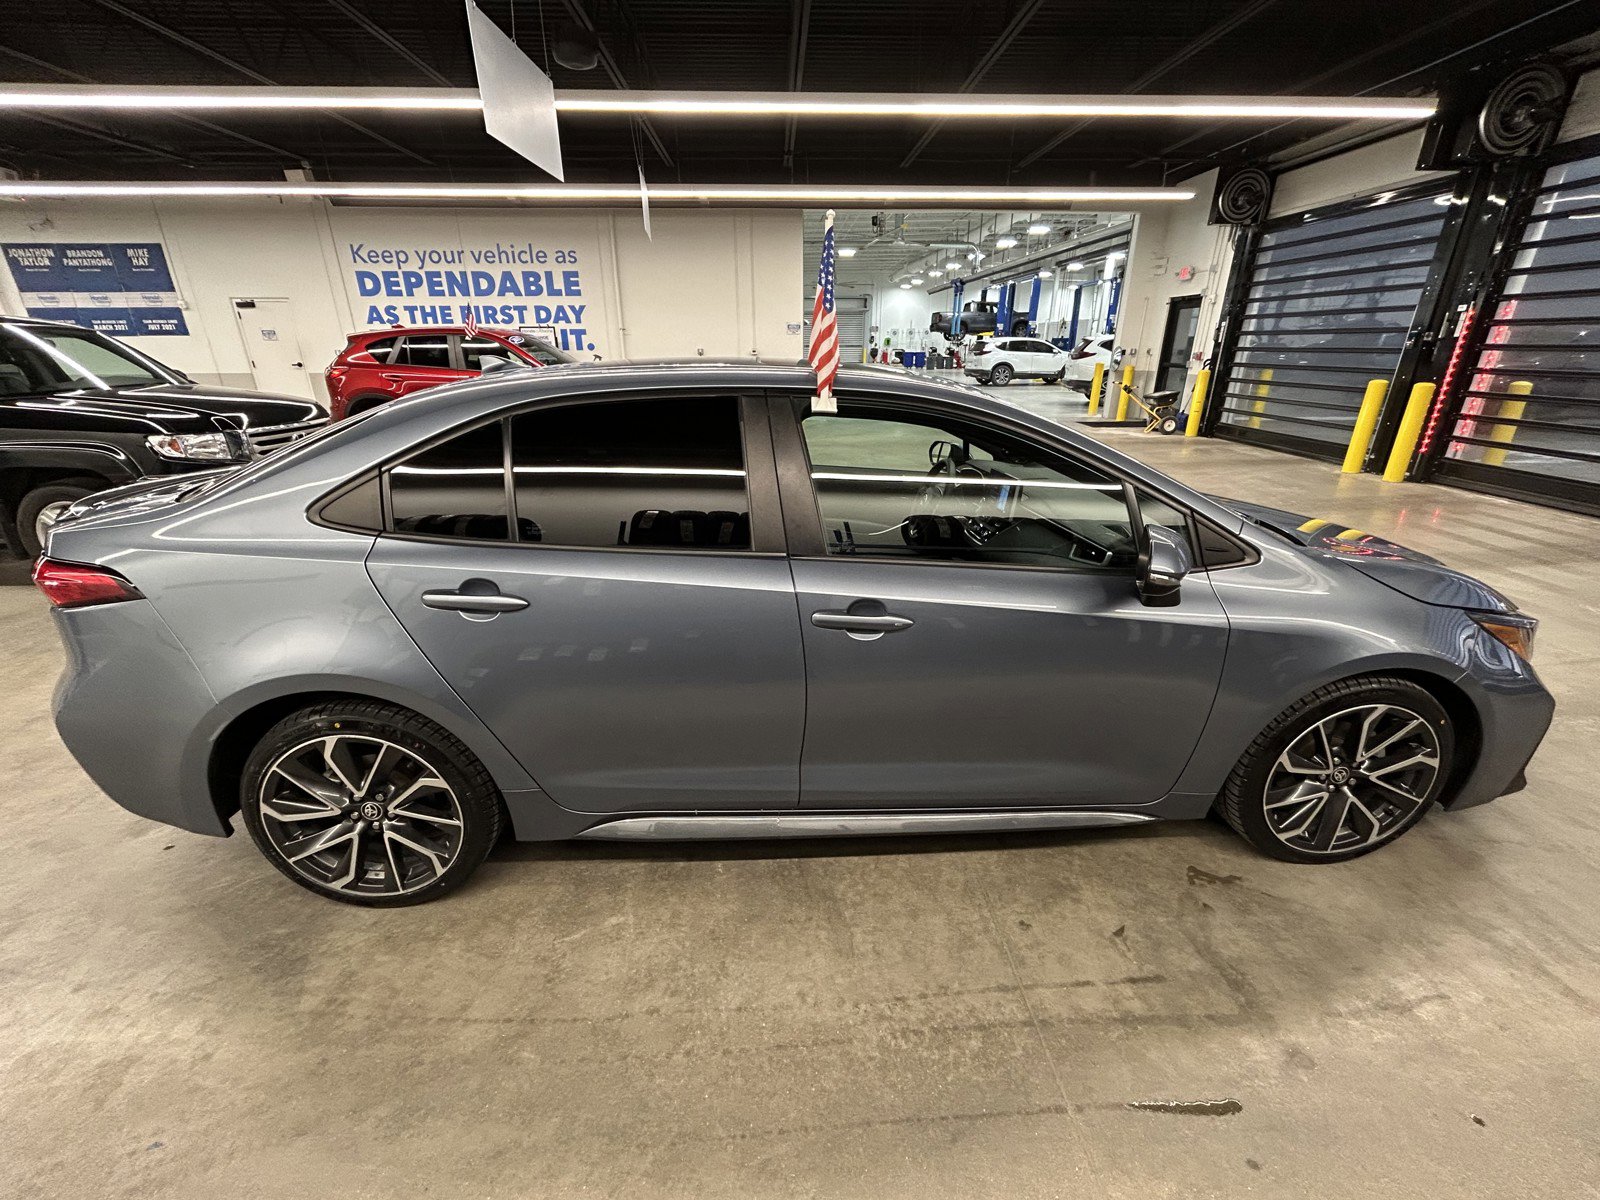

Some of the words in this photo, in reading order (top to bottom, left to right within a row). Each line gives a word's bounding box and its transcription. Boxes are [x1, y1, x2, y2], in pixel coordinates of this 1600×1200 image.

[8, 248, 55, 258] JONATHON
[66, 249, 104, 258] BRANDON
[126, 248, 149, 258] MIKE
[350, 243, 409, 269] Keep
[415, 249, 464, 269] your
[470, 243, 548, 264] vehicle
[552, 249, 578, 264] as
[18, 257, 51, 266] TAYLOR
[131, 257, 148, 266] HAY
[355, 270, 582, 297] DEPENDABLE
[366, 305, 400, 325] AS
[403, 305, 453, 325] THE
[458, 305, 528, 325] FIRST
[533, 305, 586, 324] DAY
[560, 328, 596, 351] IT.
